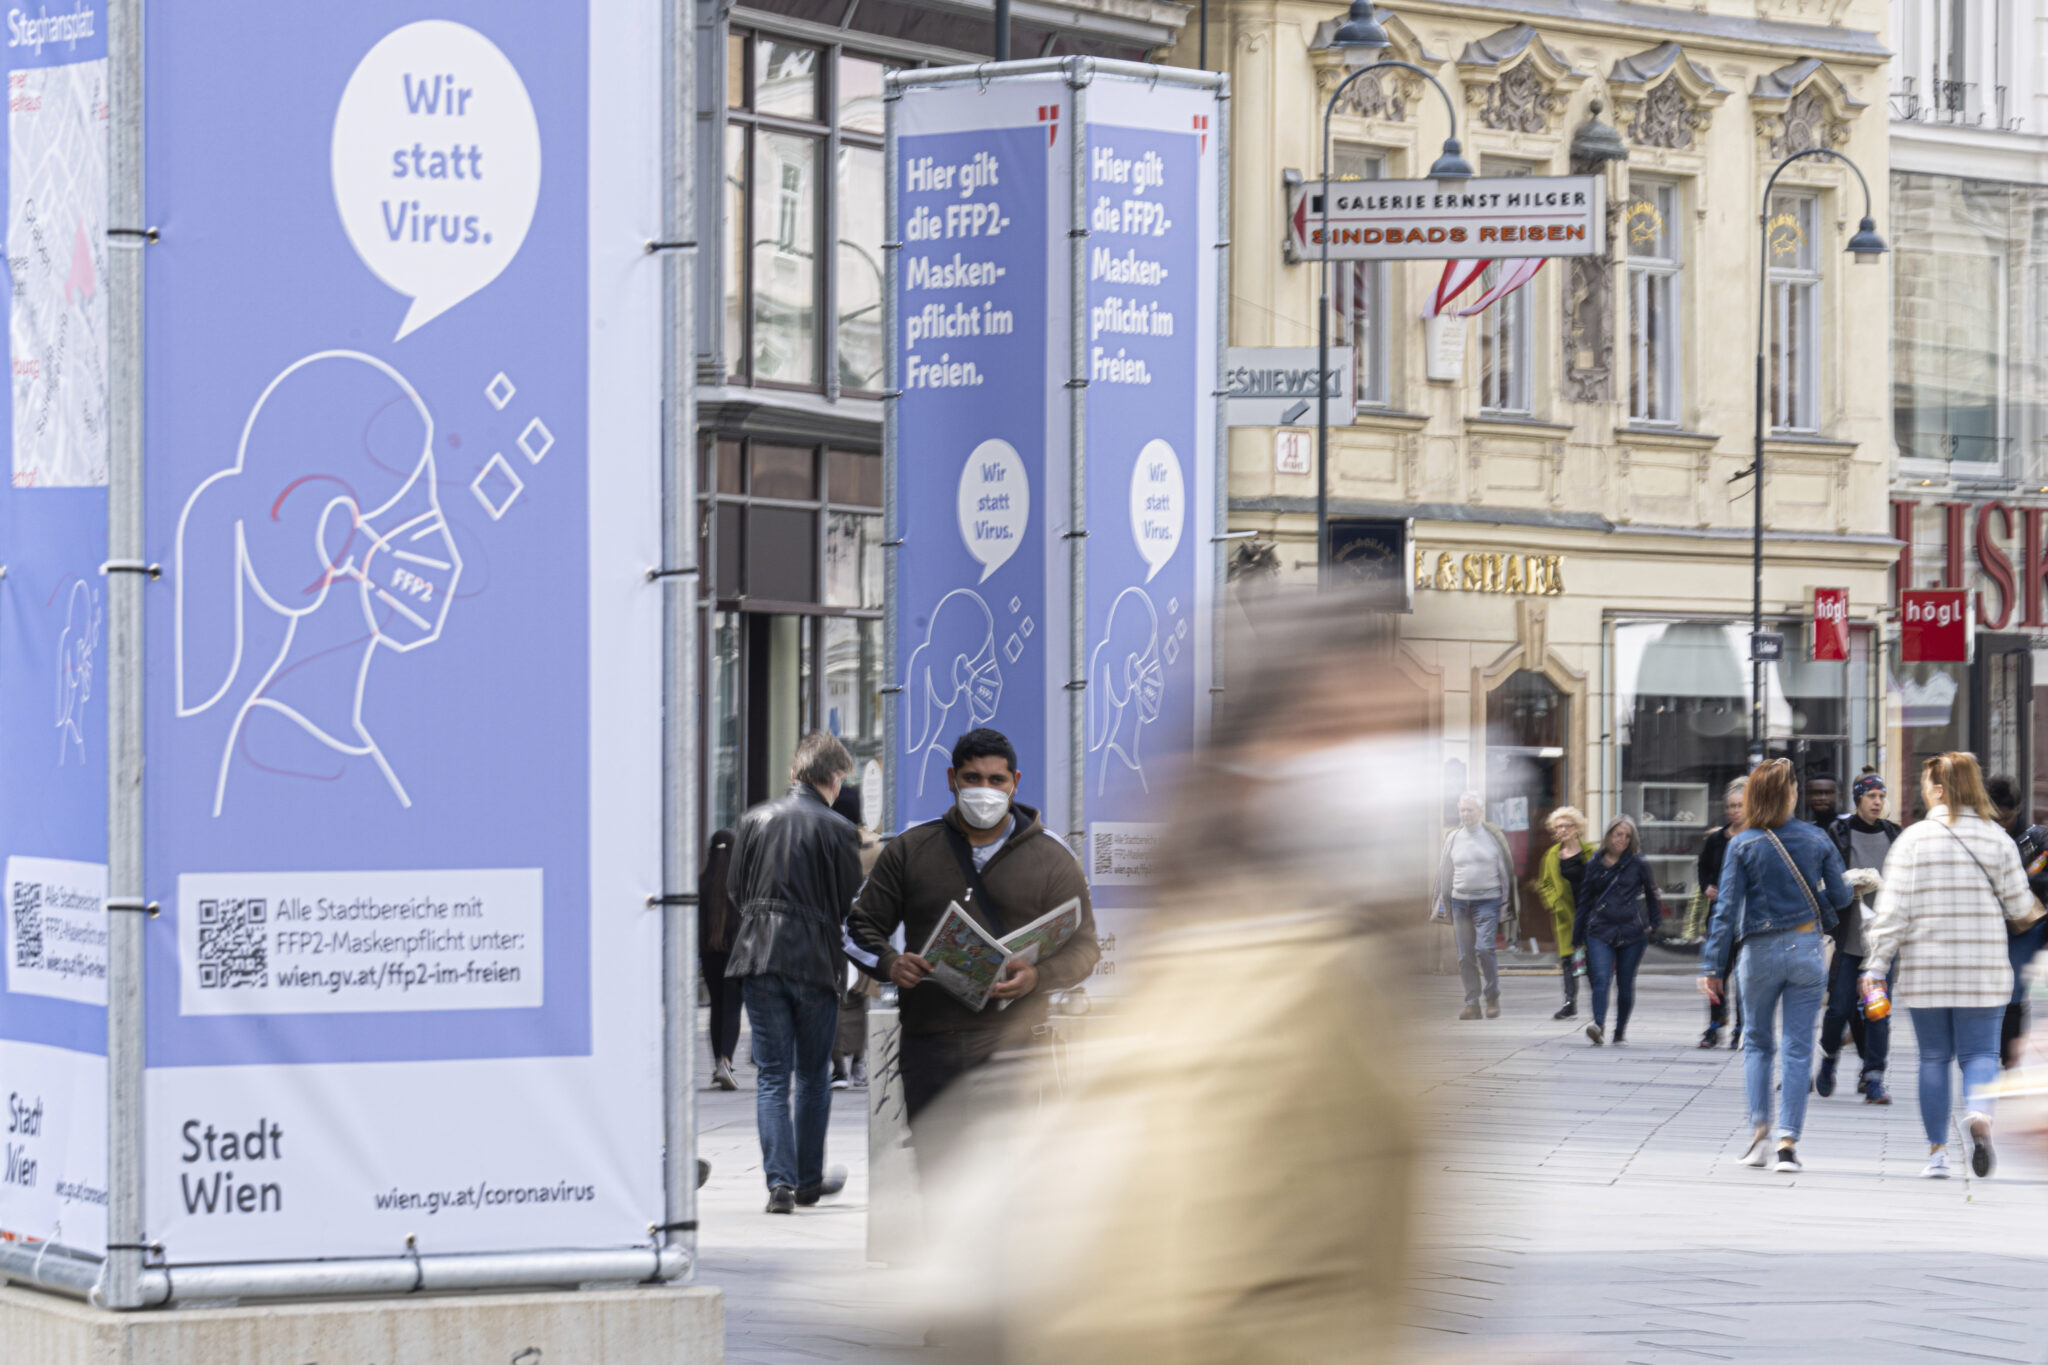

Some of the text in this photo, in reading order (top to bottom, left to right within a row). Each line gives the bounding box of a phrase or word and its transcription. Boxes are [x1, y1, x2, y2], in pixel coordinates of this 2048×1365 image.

[403, 73, 472, 117] Wir
[392, 143, 484, 181] statt
[906, 152, 999, 198] Hier gilt
[1092, 147, 1163, 196] Hier gilt
[1092, 196, 1171, 237] die FFP2-
[1337, 191, 1587, 211] GALERIE ERNST HILGER
[381, 200, 494, 245] Virus.
[906, 202, 1010, 241] die FFP2-
[1311, 224, 1587, 245] SINDBADS REISEN
[906, 253, 1006, 290] Masken-
[1091, 246, 1168, 285] Masken-
[906, 301, 1013, 349] pflicht im
[1091, 296, 1173, 341] pflicht im
[906, 353, 984, 389] Freien.
[1091, 346, 1151, 385] Freien.
[982, 462, 1007, 484] Wir
[1149, 462, 1168, 484] Wir
[977, 493, 1010, 512] statt
[1146, 494, 1171, 511] statt
[974, 520, 1013, 540] Virus.
[1143, 519, 1173, 540] Virus.
[391, 567, 434, 603] FFP2
[276, 895, 483, 922] Alle Stadtbereiche mit
[276, 928, 525, 958] FFP2-Maskenpflicht unter:
[277, 960, 521, 994] wien.gv.at/ffp2-im-freien
[9, 1091, 43, 1137] Stadt
[181, 1117, 284, 1163] Stadt
[3, 1142, 37, 1188] Wien
[181, 1170, 283, 1215] Wien
[375, 1179, 596, 1216] wien.gv.at/coronavirus
